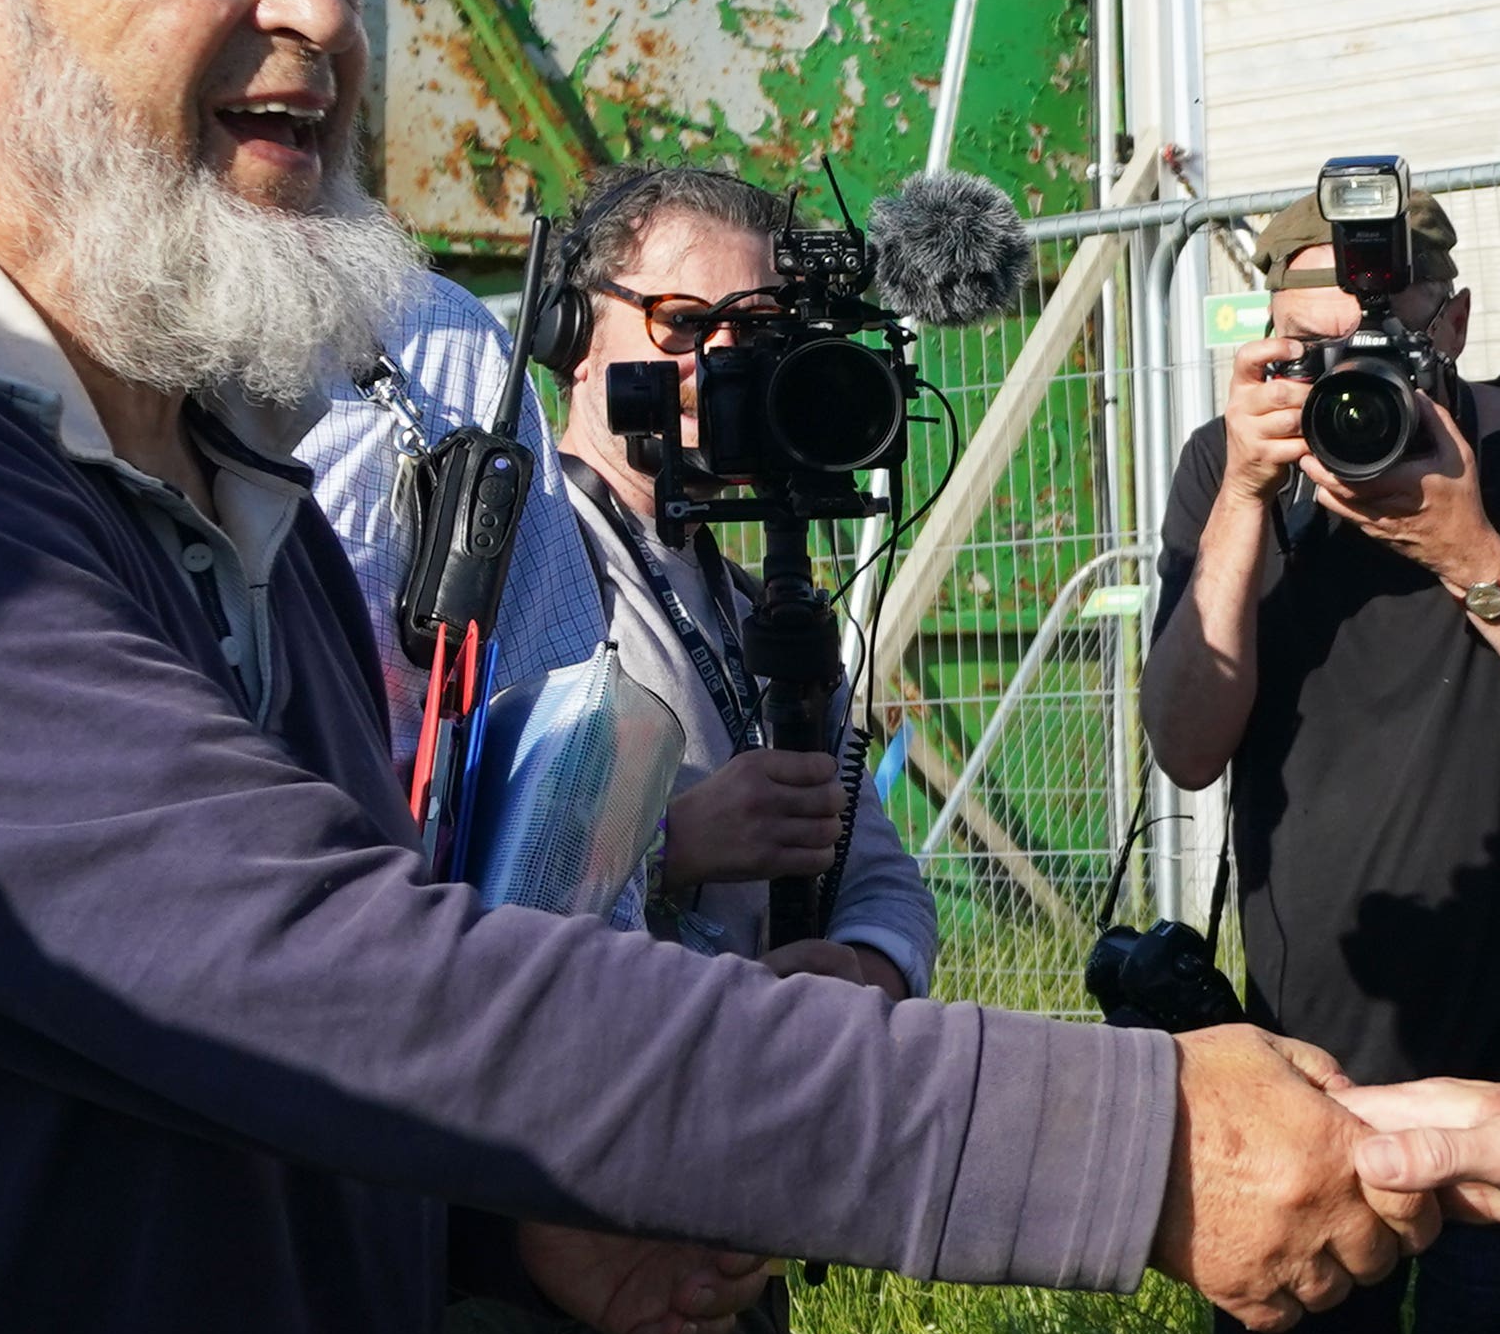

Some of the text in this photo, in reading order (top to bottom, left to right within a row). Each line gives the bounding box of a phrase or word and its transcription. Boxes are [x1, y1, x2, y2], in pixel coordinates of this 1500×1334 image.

[1352, 334, 1388, 347] Nikon
[661, 588, 695, 636] BBC
[690, 645, 724, 695] BBC
